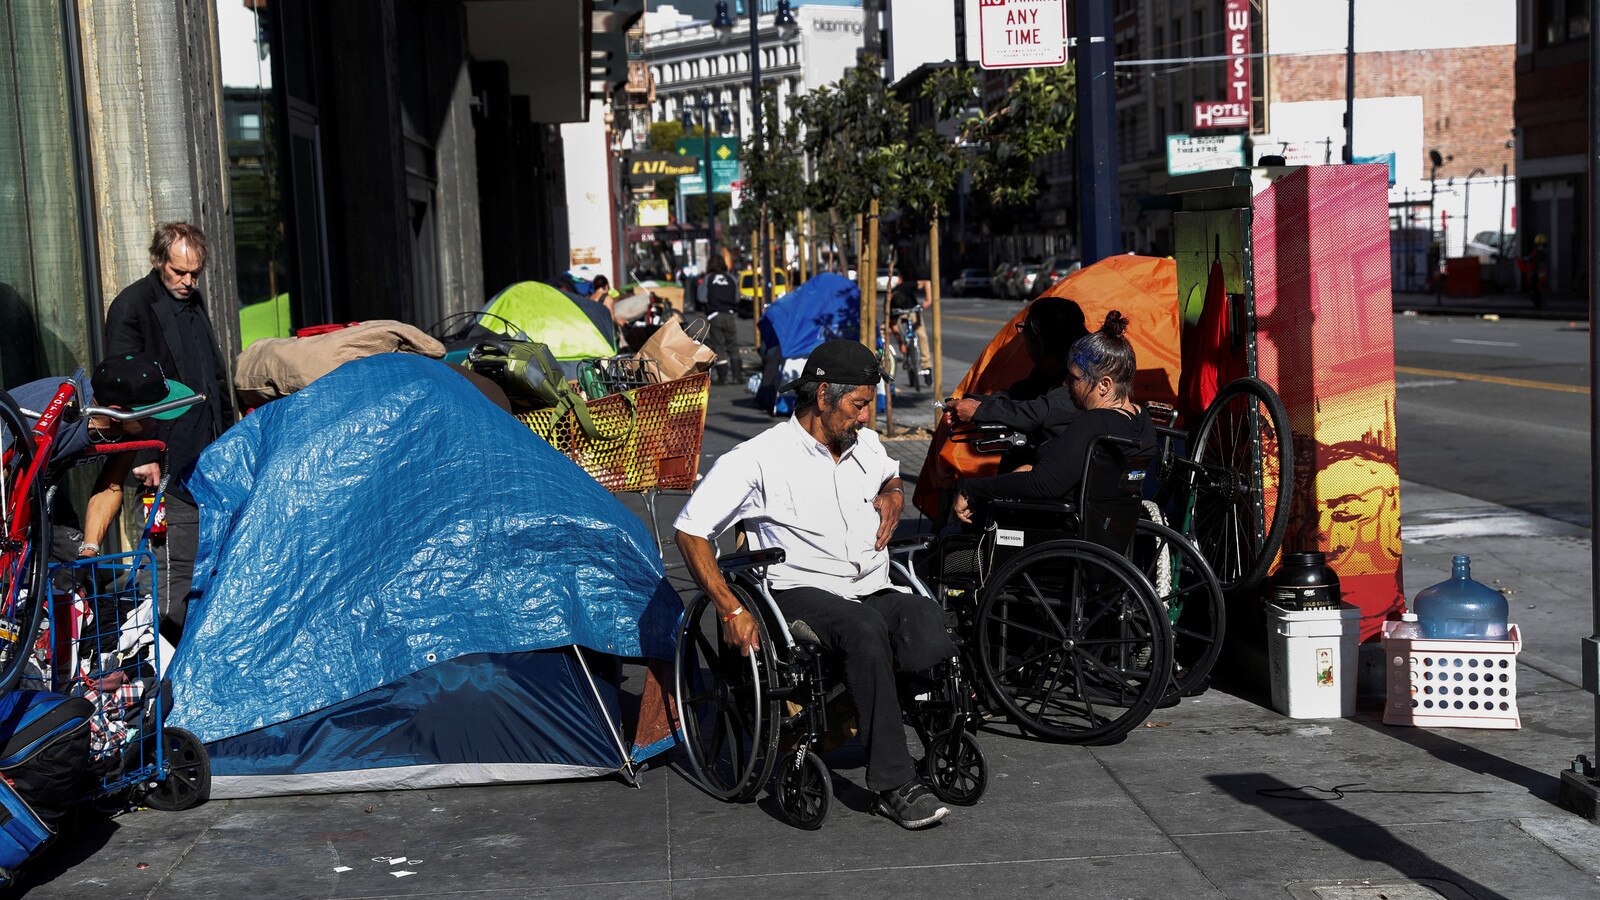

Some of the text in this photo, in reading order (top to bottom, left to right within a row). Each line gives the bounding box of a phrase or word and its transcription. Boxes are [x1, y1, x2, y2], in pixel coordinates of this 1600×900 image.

[1006, 8, 1038, 25] ANY
[1005, 28, 1041, 46] TIME
[1228, 10, 1248, 100] WEST
[1195, 103, 1249, 127] HOTEL
